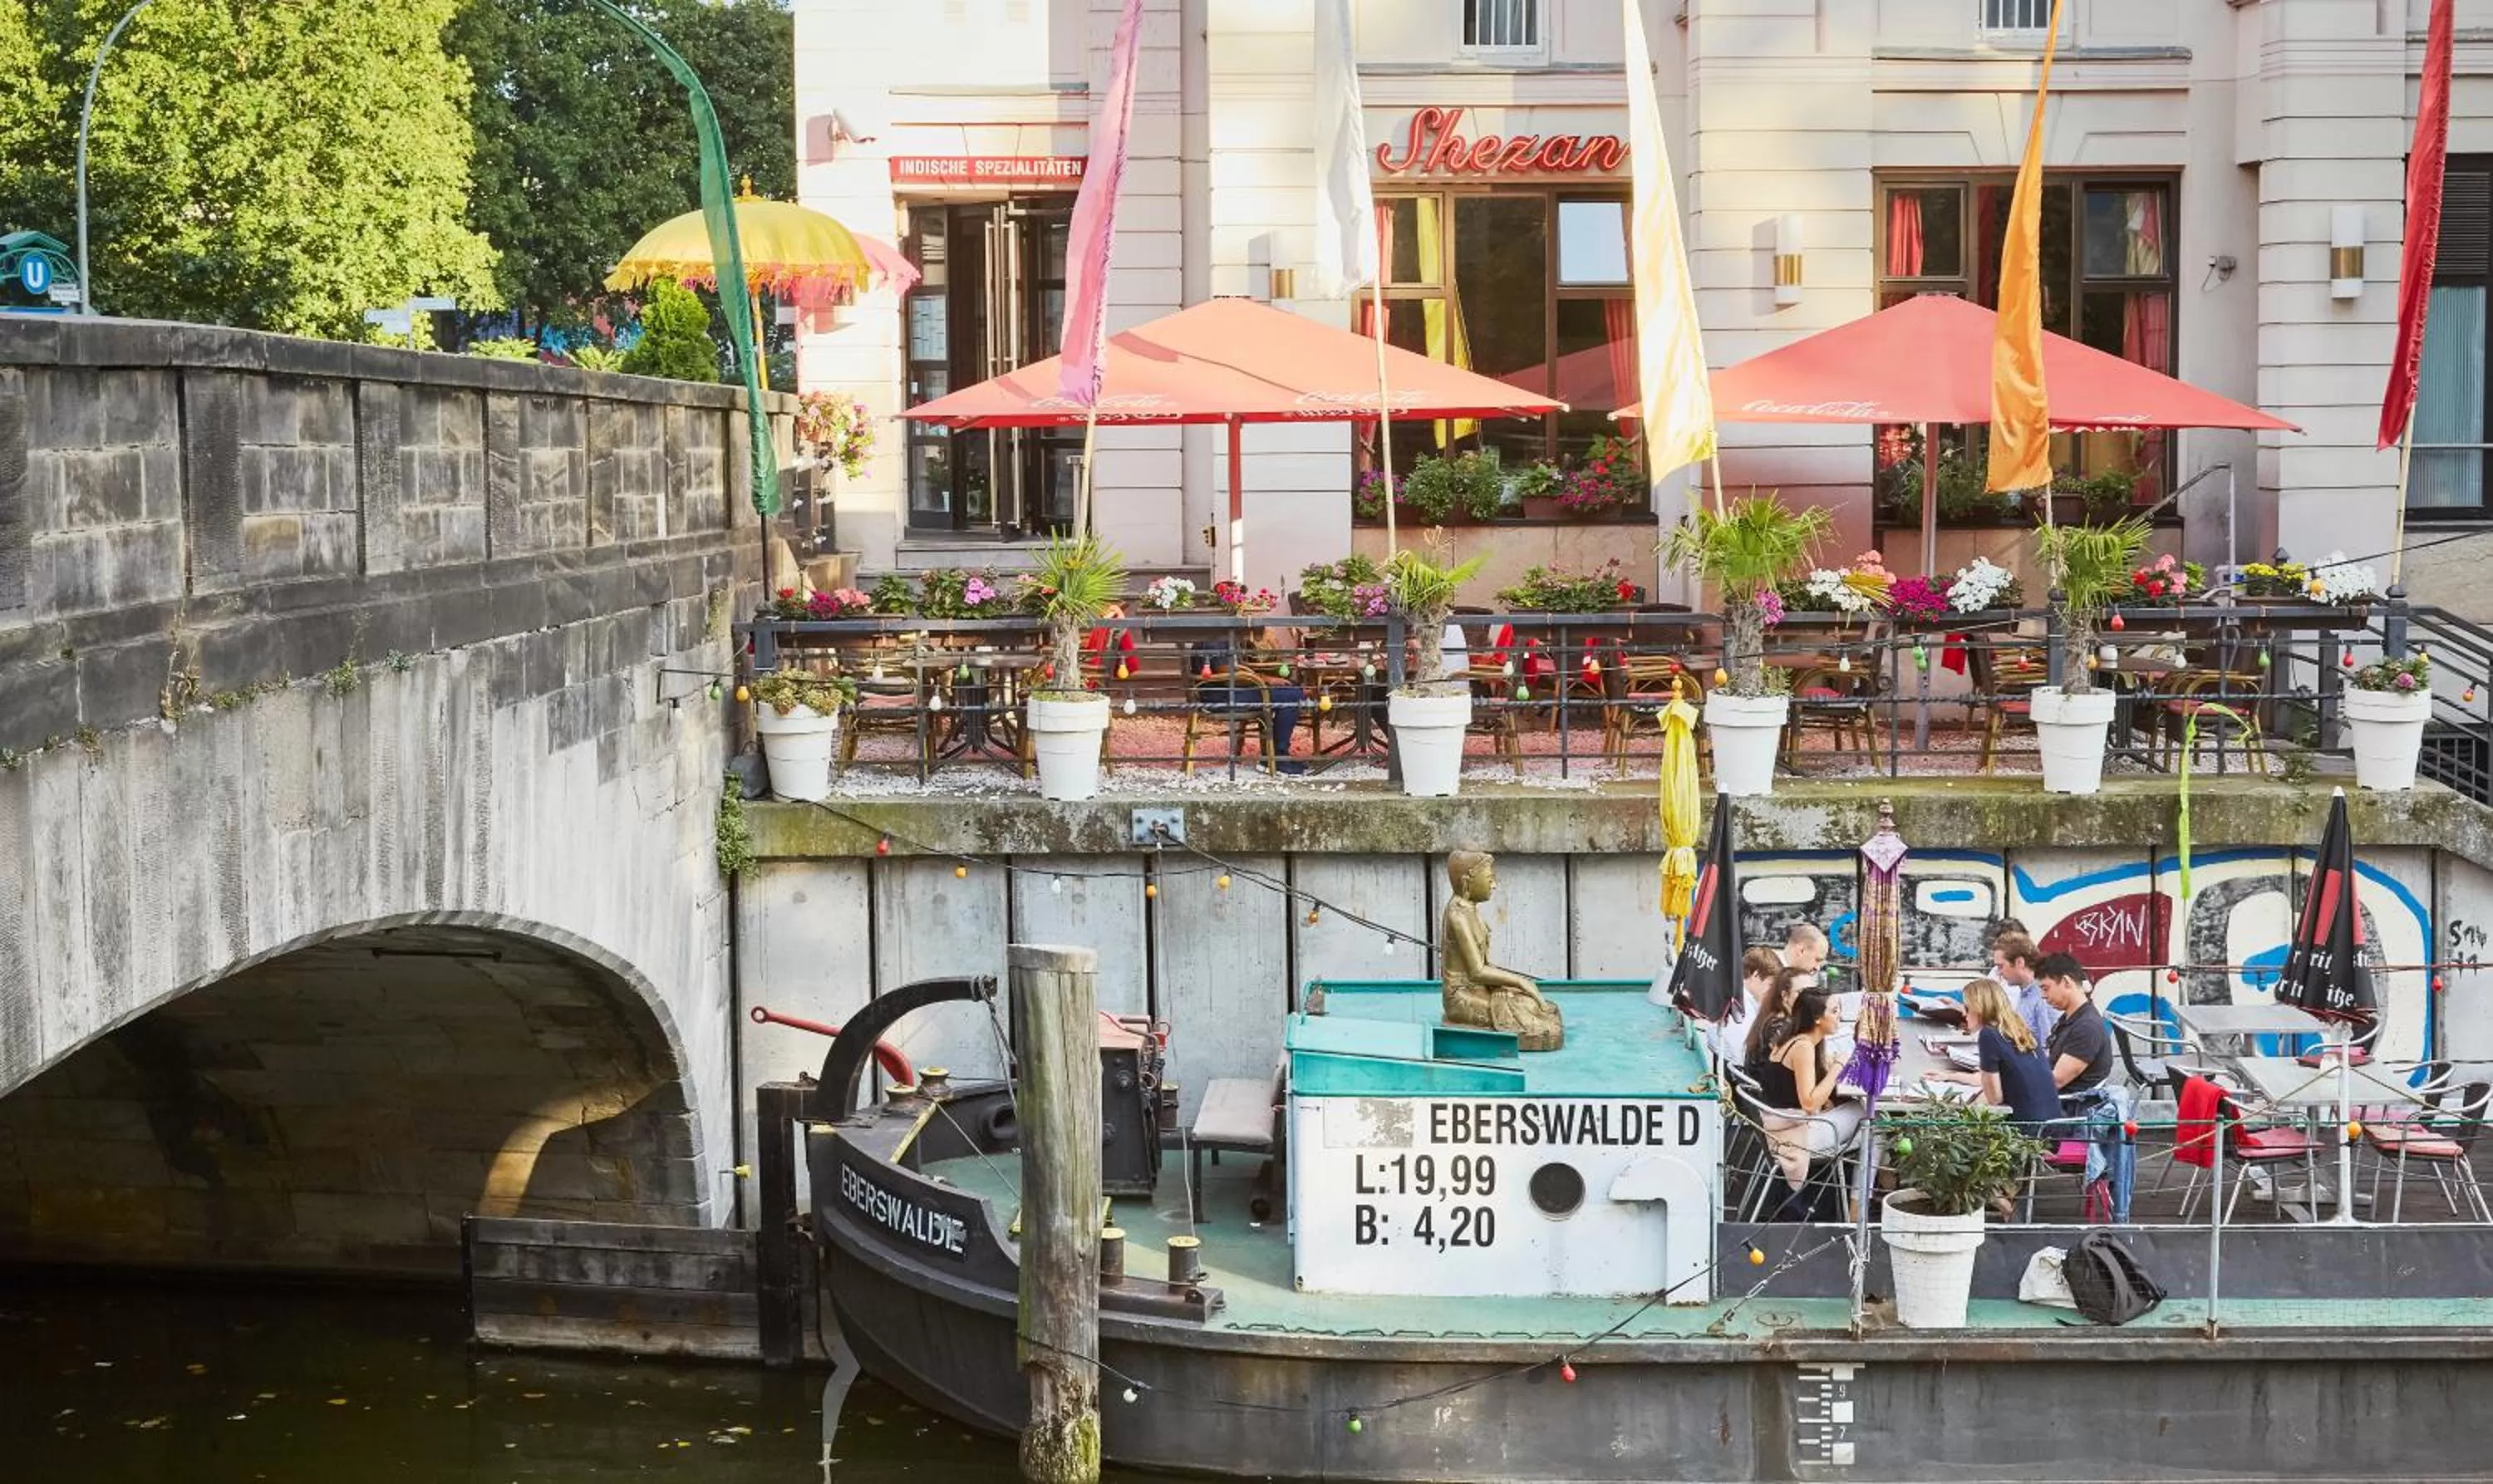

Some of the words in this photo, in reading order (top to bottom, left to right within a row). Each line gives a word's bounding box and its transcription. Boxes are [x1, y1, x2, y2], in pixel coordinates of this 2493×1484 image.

[1376, 106, 1630, 172] Shezan
[900, 159, 967, 175] INDISCHE
[975, 157, 1081, 176] SPEZIALITÄTEN
[27, 262, 43, 288] U
[1430, 1103, 1663, 1146] EBERSWALDE
[1679, 1106, 1700, 1146] D
[1355, 1204, 1388, 1246] B:
[1413, 1206, 1495, 1254] 4,20
